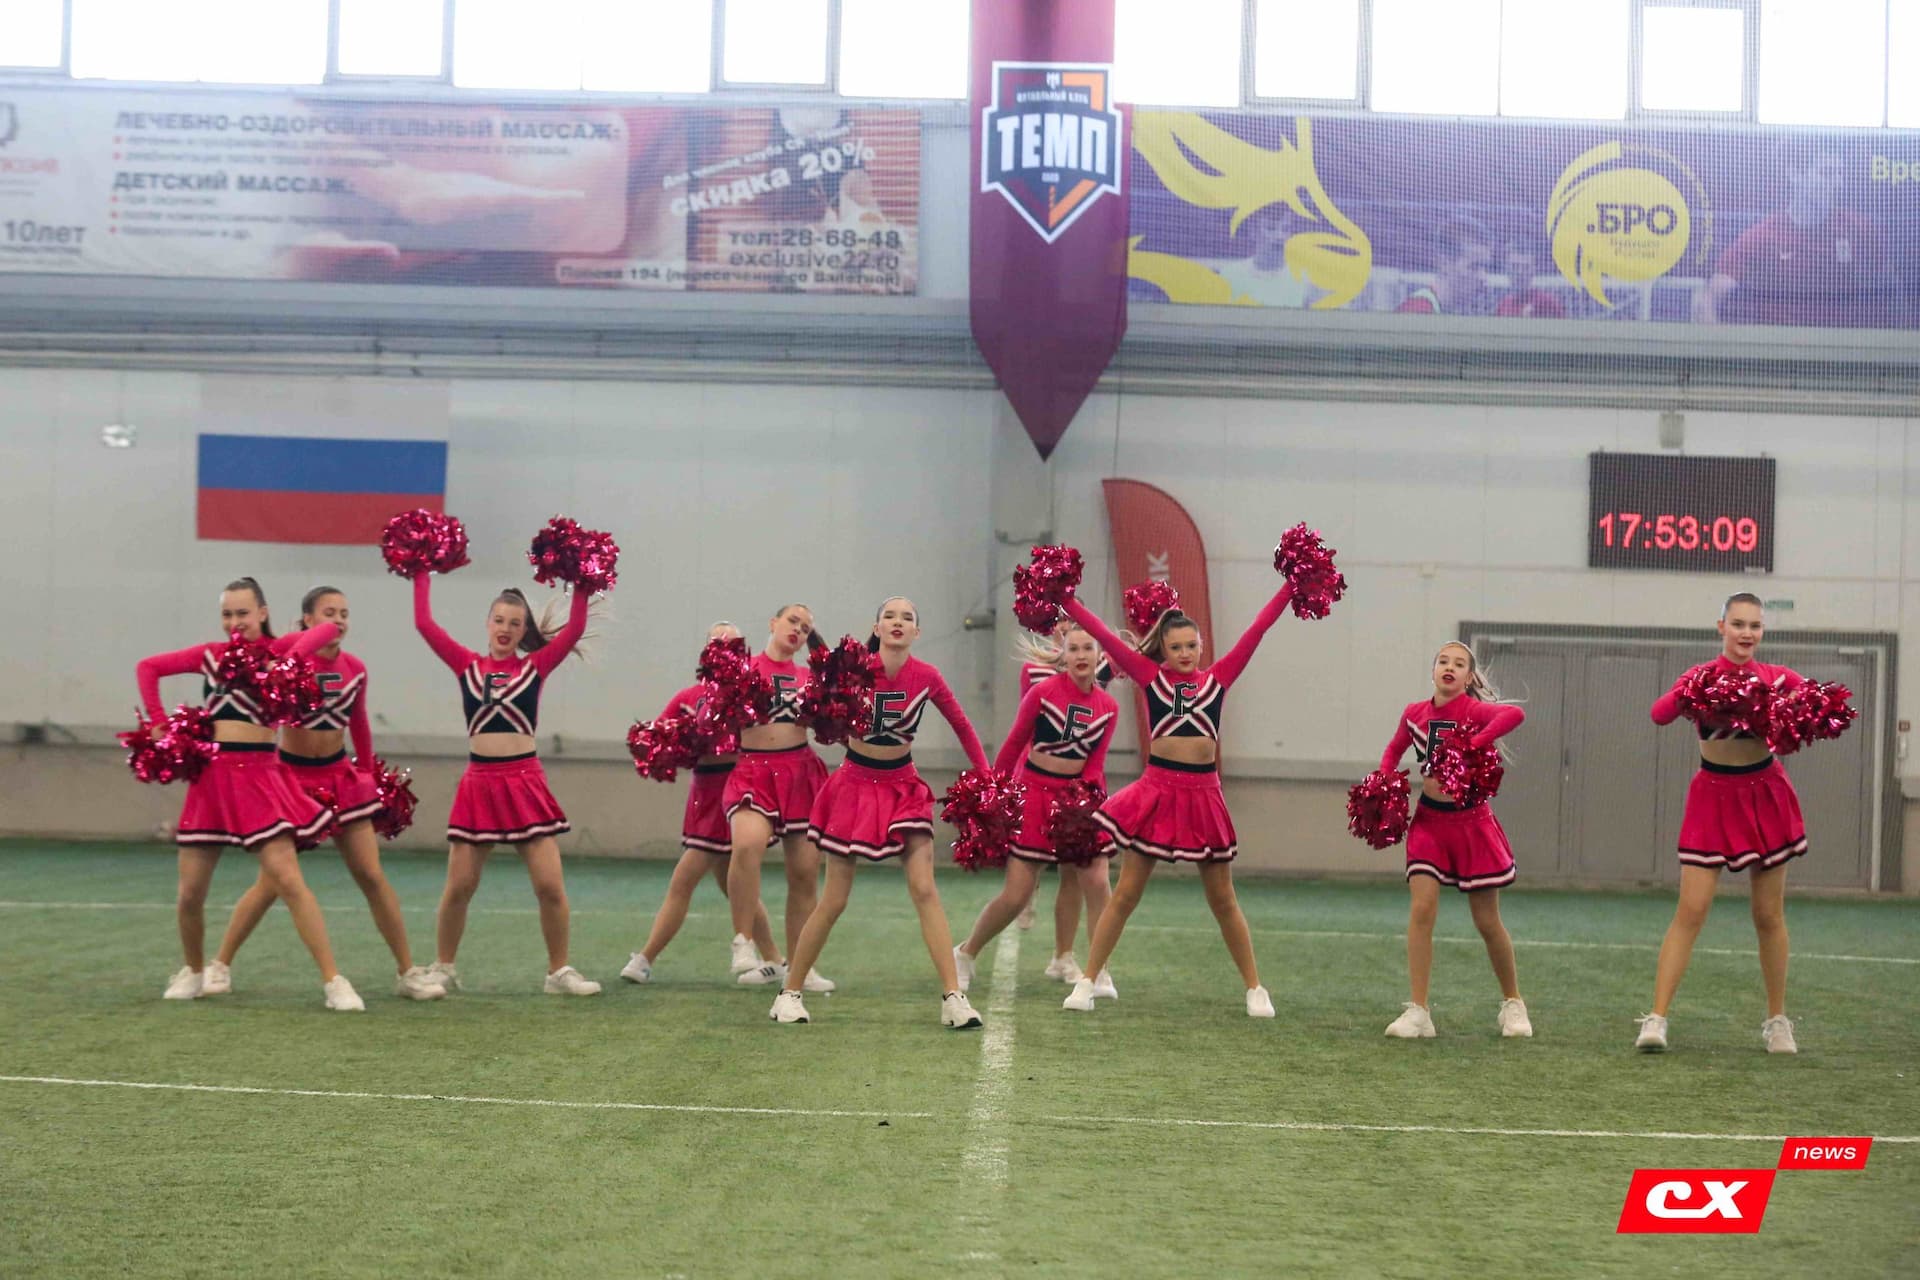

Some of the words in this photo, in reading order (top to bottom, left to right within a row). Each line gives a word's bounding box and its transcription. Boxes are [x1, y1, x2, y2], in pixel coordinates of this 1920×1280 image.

[115, 111, 492, 138] ЛЕЧЕБНО-ОЗДОРОВИТЕЛЬНЫЙ
[799, 138, 875, 181] 20%
[997, 113, 1107, 175] ТЕМП
[113, 170, 227, 191] ДЕТСКИЙ
[1586, 203, 1677, 236] .БРО
[630, 267, 660, 279] 194
[729, 249, 898, 270] exclusive22.ru
[1599, 512, 1758, 552] 17:53:09
[872, 691, 908, 735] F
[1172, 682, 1198, 717] F
[1062, 703, 1093, 742] F
